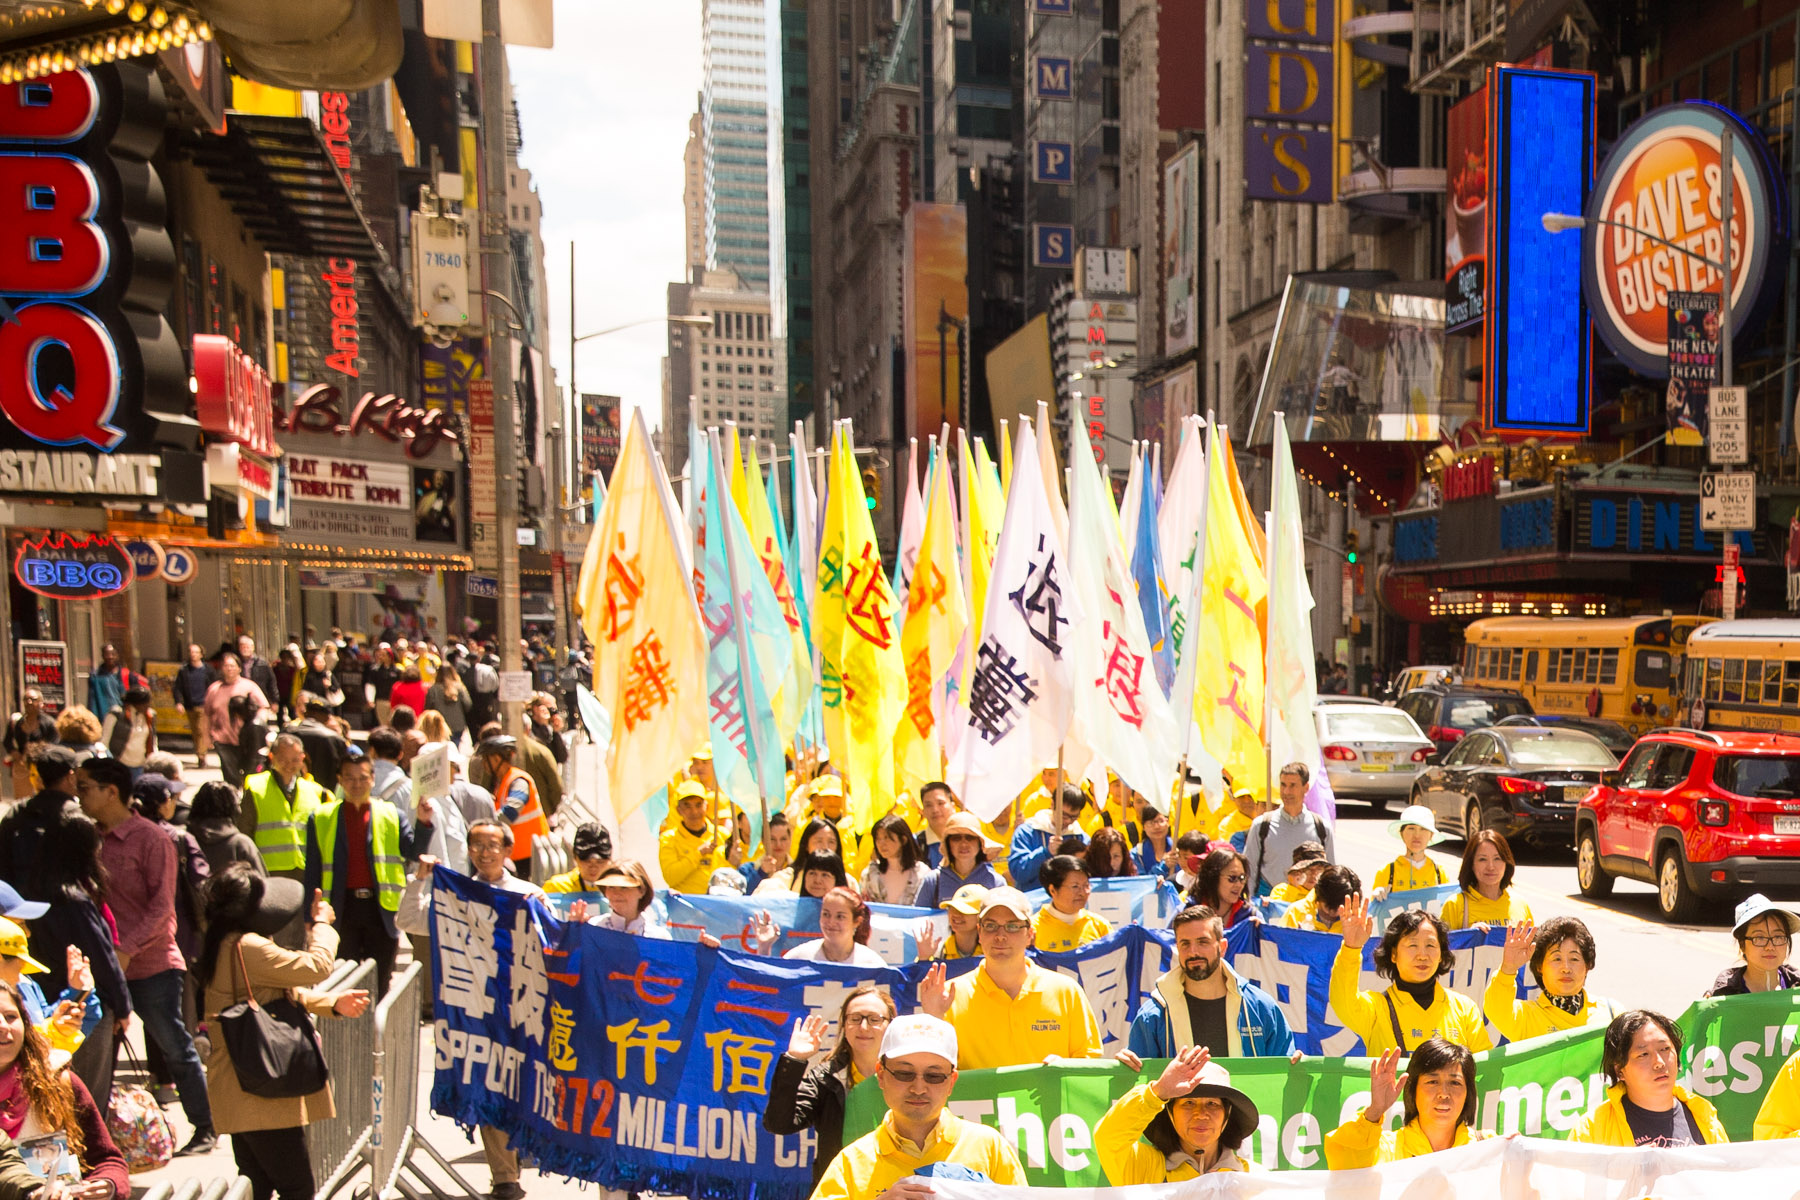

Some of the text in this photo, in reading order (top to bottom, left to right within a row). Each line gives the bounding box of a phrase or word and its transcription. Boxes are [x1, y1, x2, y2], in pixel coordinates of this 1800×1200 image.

[1038, 0, 1070, 258] MPS
[1613, 163, 1737, 266] DAVE &
[1458, 265, 1478, 298] Right
[1447, 293, 1483, 326] Across The
[1669, 300, 1719, 312] CELEBRATES
[323, 257, 359, 378] Americ
[1670, 339, 1719, 355] THE NEW
[1669, 365, 1717, 380] THEATER
[1717, 391, 1738, 403] BUS
[1714, 405, 1741, 418] LANE
[1719, 432, 1736, 440] FINE
[289, 457, 370, 481] RAT PACK
[289, 479, 354, 500] TRIBUTE
[1717, 478, 1751, 489] BUSES
[1720, 494, 1748, 504] ONLY
[1590, 498, 1756, 555] DIN
[35, 550, 110, 563] DALLAS
[23, 558, 122, 590] BBQ
[25, 664, 62, 677] DEAL
[616, 1091, 758, 1168] MILLION
[948, 1095, 1092, 1172] The
